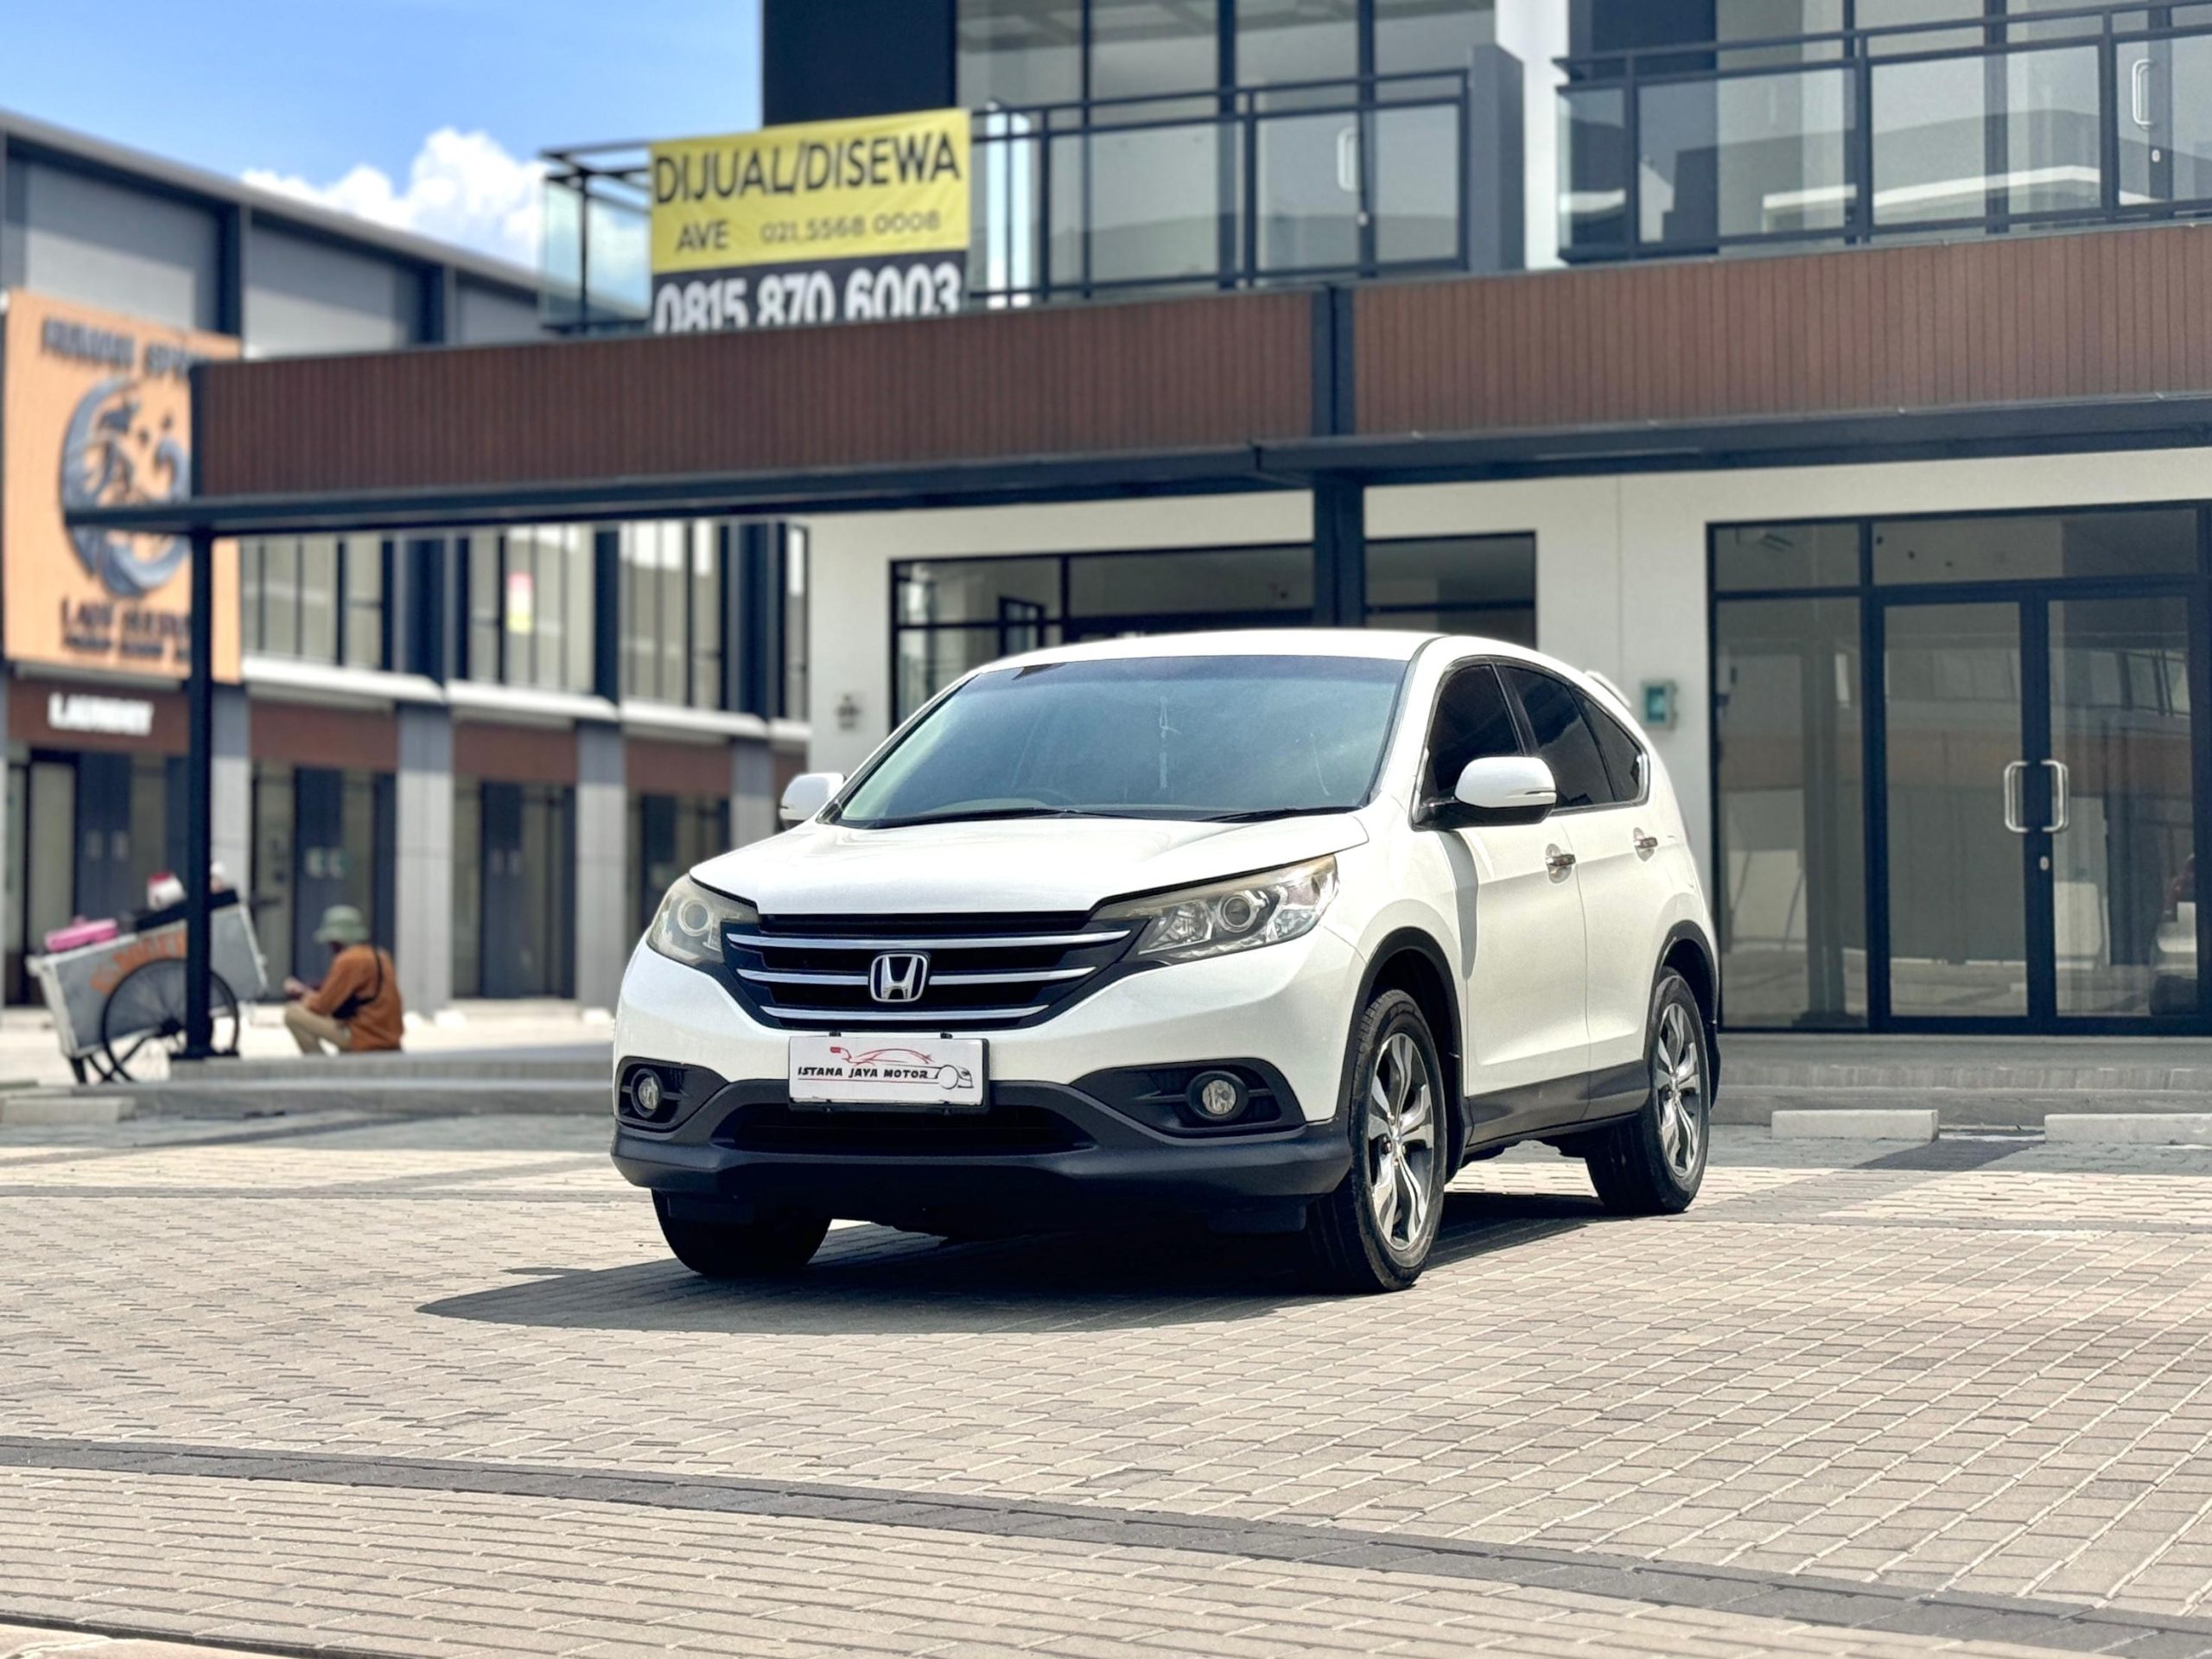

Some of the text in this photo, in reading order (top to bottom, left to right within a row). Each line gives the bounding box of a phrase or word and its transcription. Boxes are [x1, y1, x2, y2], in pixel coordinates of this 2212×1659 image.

[654, 131, 961, 204] DIJUAL/DISEWA
[677, 220, 728, 251] AVE
[756, 270, 836, 327] 870
[798, 1066, 928, 1079] ISTANA JAYA MOTOR
